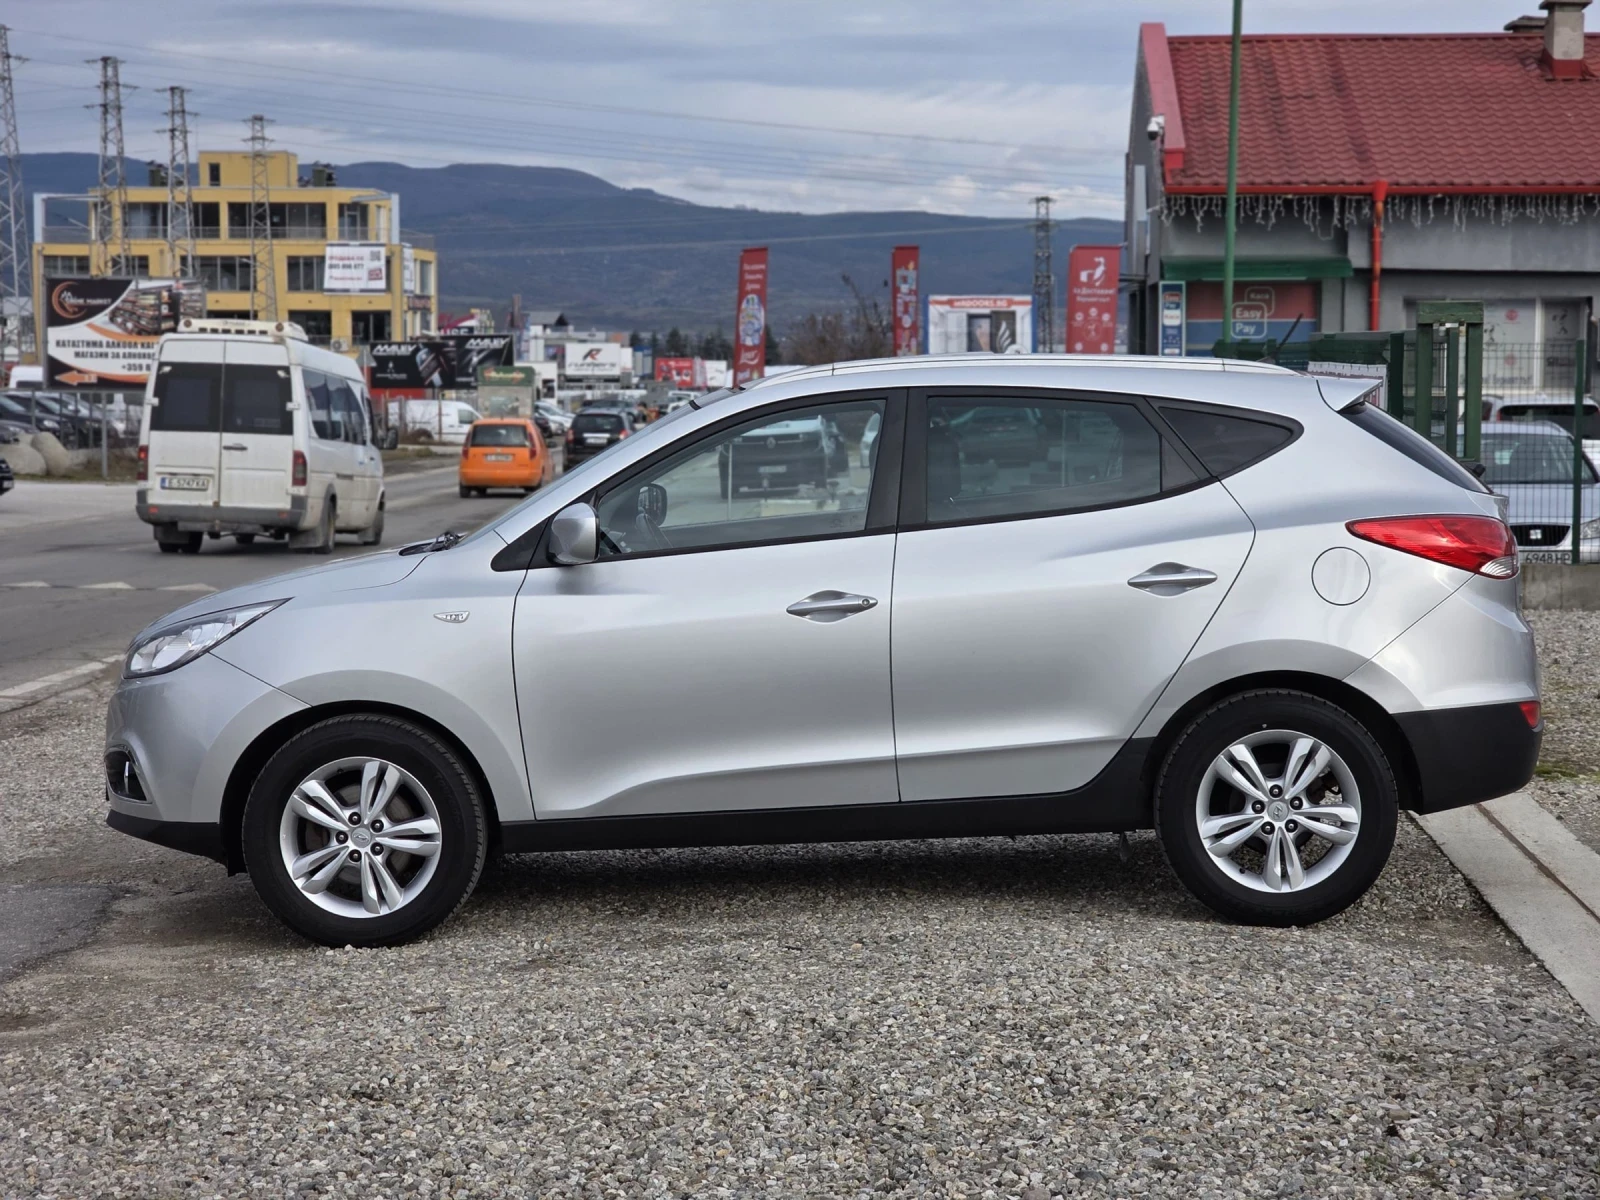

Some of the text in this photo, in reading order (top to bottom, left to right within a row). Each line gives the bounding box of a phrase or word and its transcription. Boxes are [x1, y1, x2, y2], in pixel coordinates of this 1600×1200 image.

[1235, 307, 1262, 320] Easy
[1235, 322, 1256, 335] Pay
[74, 351, 109, 359] МАГАЗИН
[111, 351, 121, 359] ЗА
[121, 363, 143, 372] +359
